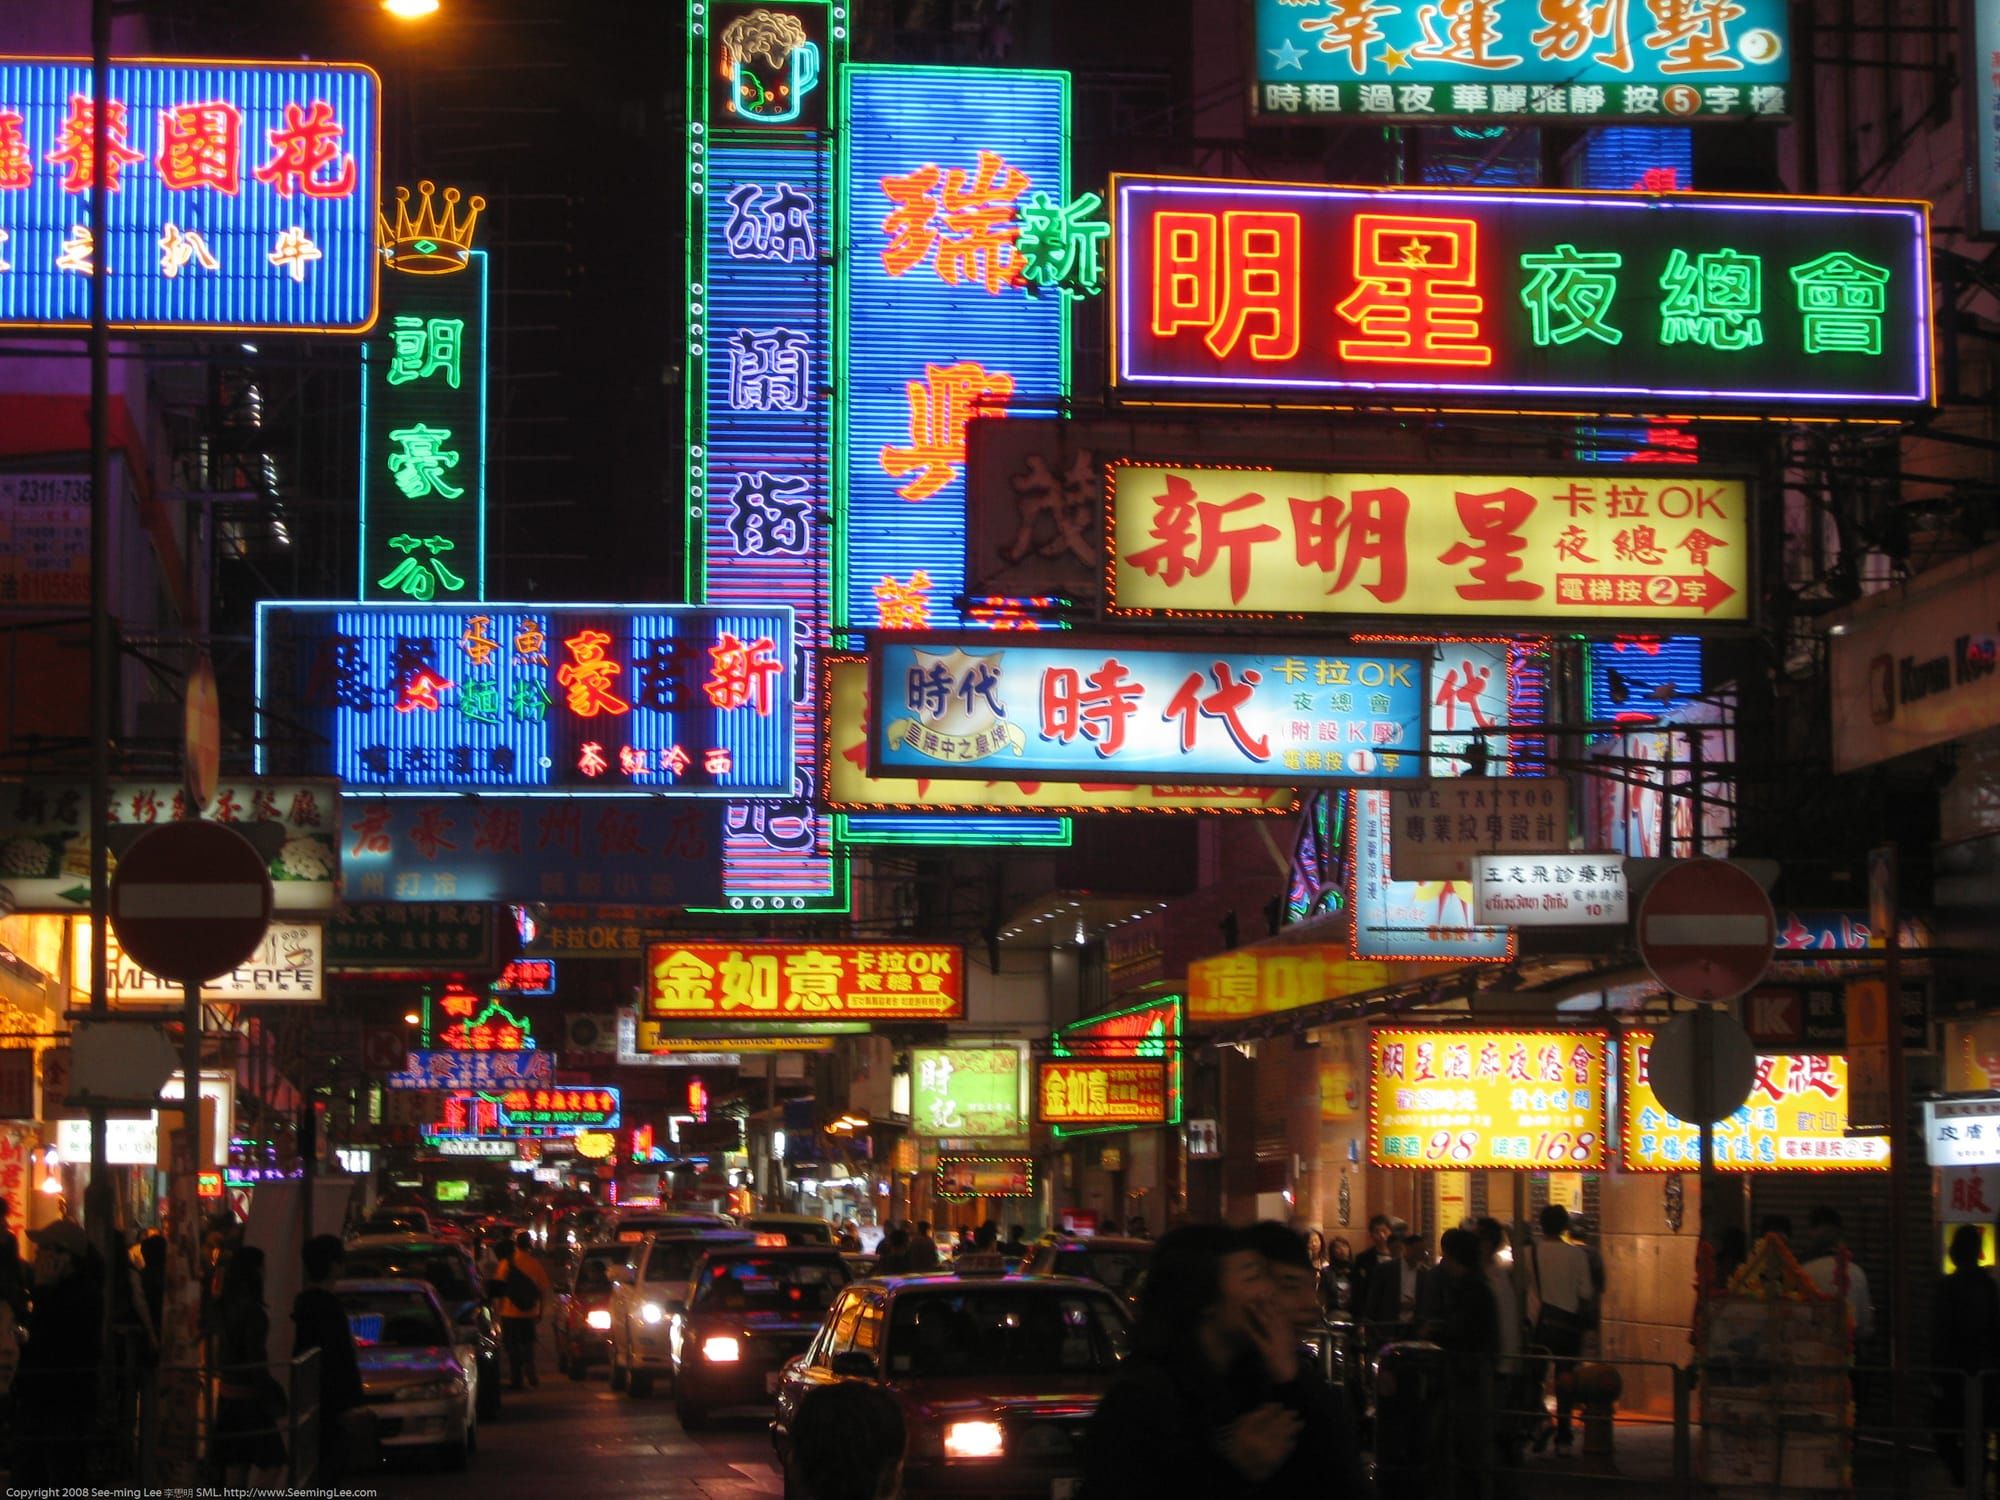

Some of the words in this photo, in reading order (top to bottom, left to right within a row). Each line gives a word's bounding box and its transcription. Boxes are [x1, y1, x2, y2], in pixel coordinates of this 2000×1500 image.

[1266, 85, 1341, 114] 時租
[1359, 85, 1435, 114] 過夜
[1453, 85, 1606, 114] 華麗雅靜
[1552, 484, 1728, 519] 卡拉OK
[1124, 473, 1545, 607] 新明星
[1553, 524, 1730, 567] 夜總會
[1272, 658, 1412, 688] 卡拉OK
[908, 663, 1006, 722] 時代
[1293, 692, 1391, 714] 夜總會
[1040, 656, 1272, 763] 時代
[232, 968, 314, 984] CAFE
[848, 951, 952, 975] 卡拉OK
[654, 950, 843, 1012] 金如意
[1045, 1069, 1108, 1116] 金如意
[1797, 1111, 1849, 1132] 歡迎
[1426, 1131, 1478, 1160] 98
[1534, 1131, 1595, 1161] 168
